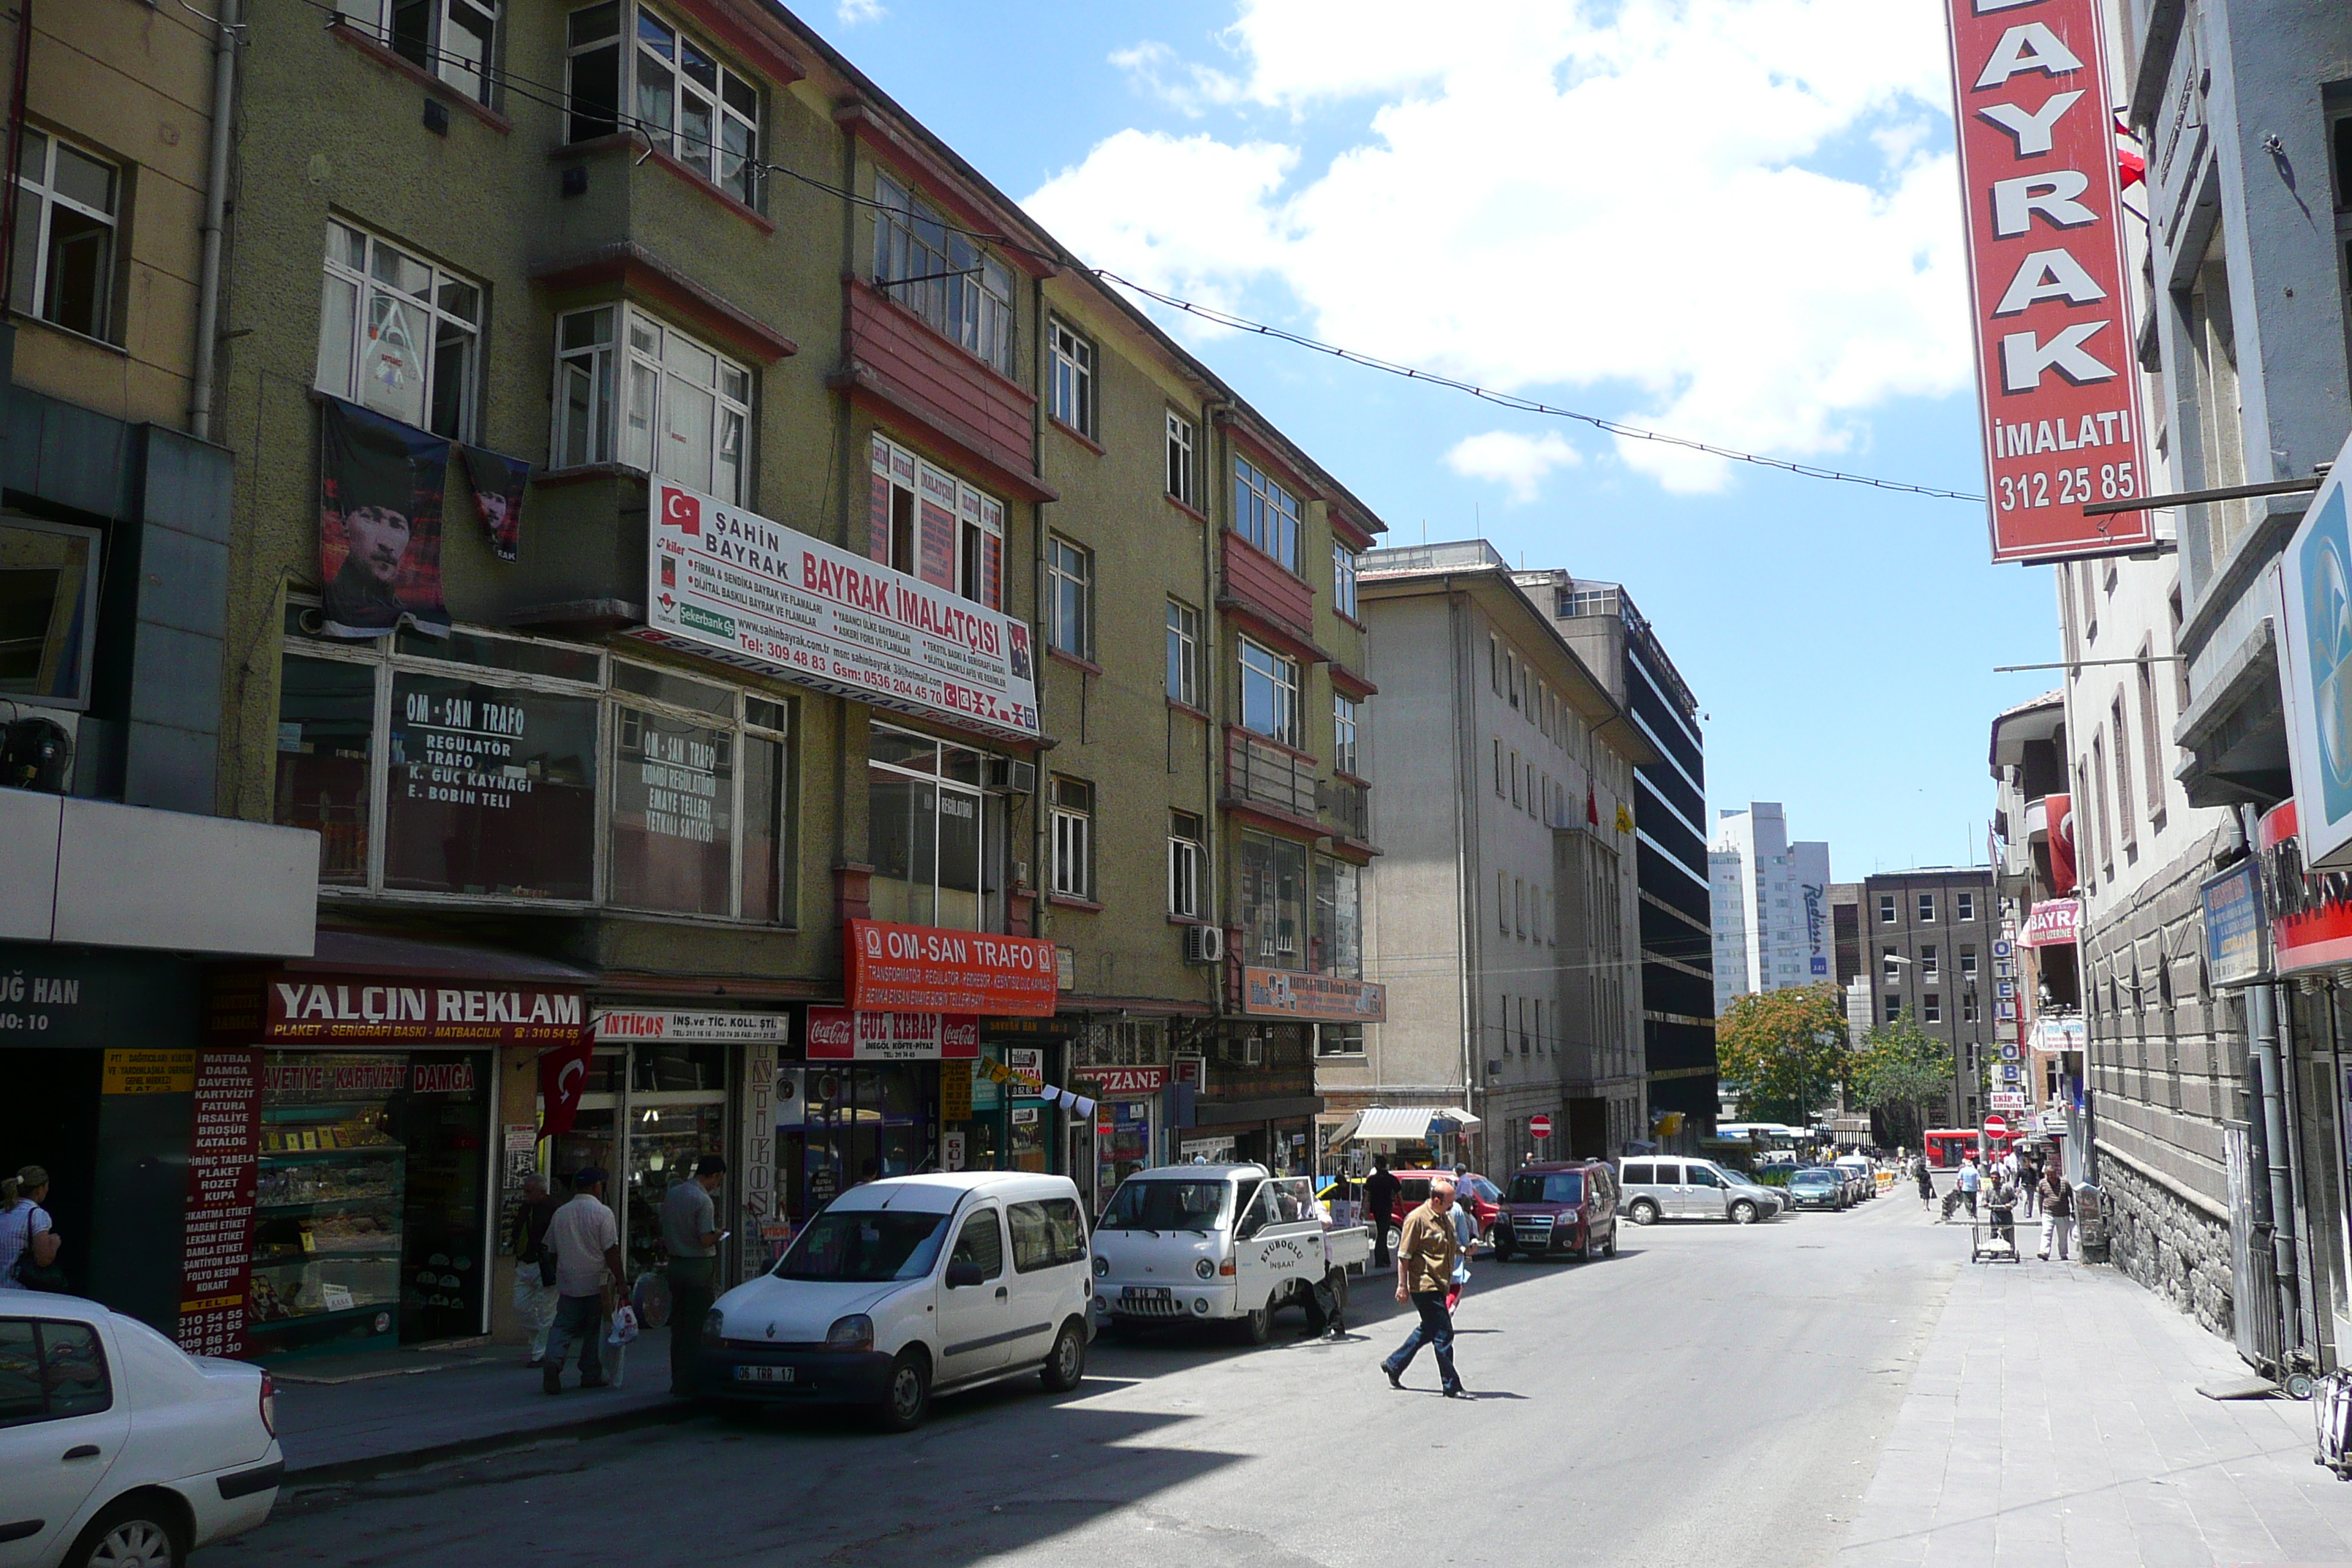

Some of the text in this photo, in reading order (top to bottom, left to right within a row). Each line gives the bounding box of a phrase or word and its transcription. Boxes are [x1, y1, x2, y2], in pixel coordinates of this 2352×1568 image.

[1970, 0, 2119, 391] AYRAK
[1994, 410, 2129, 459] İMALATI
[1999, 461, 2135, 511] 312 25 85
[715, 512, 779, 552] ŞAHİN
[666, 540, 685, 557] kiler
[706, 532, 788, 580] BAYRAK
[694, 559, 823, 614] FİRMA SENDİKA BAYRAK VE FLAMALARI
[694, 576, 817, 627] DİJİTAL BASKILI BAYRAK VE FLAMALAR
[802, 551, 1000, 655] BAYRAK İMALATÇISI
[680, 606, 723, 630] Şekerbank
[738, 618, 850, 660] www.sahinbayrak.com.tr msn:
[740, 633, 942, 704] Tel: 309 48 83 Gsm: 0536 204 45 70
[791, 676, 919, 712] BAYRAK
[407, 693, 524, 735] OM SAN TRAFO
[426, 734, 510, 757] REGÜLATÖR
[644, 731, 715, 770] OM SAN TRAFO
[426, 750, 473, 768] TRAFO
[410, 766, 461, 785] K. GÜÇ
[642, 764, 716, 797] KOMBİ REGÜLATÖRÜ
[429, 786, 475, 804] BOBİN
[482, 793, 510, 808] TELİ
[649, 788, 711, 821] EMAYE TELLERİ
[646, 810, 714, 843] YETKİLİ SATICISI
[1801, 883, 1827, 955] Radisson
[888, 932, 967, 963] OM-SAN
[973, 941, 1033, 970] TRAFO
[1994, 941, 2013, 1017] OTEL
[33, 977, 80, 1004] HAN
[276, 982, 581, 1025] YALÇIN REKLAM
[29, 1014, 49, 1030] 10
[274, 1021, 579, 1039] PLAKET SERİGRAFİ BASKI MATBAACILIK 310 54 55
[708, 1016, 727, 1027] TİC.
[730, 1018, 757, 1028] KOLL.
[760, 1017, 777, 1030] ŞTİ.
[892, 1012, 938, 1040] KEBAP
[865, 1040, 889, 1049] İNEGÖL
[203, 1054, 252, 1063] MATBAA
[206, 1066, 248, 1075] DAMGA
[334, 1060, 475, 1093] KARTVİZİT DAMGA
[197, 1076, 253, 1087] DAVETİYE
[195, 1088, 255, 1099] KARTVİZİT
[201, 1101, 246, 1111] FATURA
[197, 1112, 249, 1123] İRSALİYE
[198, 1124, 246, 1137] BROŞÜR
[196, 1137, 247, 1147] KATALOG
[220, 1154, 255, 1165] TABELA
[197, 1166, 241, 1177] PLAKET
[201, 1178, 238, 1190] ROZET
[204, 1191, 235, 1202] KUPA
[225, 1206, 252, 1218] ETİKET
[186, 1218, 246, 1233] MADENİ ETİKET
[186, 1230, 245, 1245] LEKSAN ETİKET
[186, 1243, 244, 1257] DAMLA ETİKET
[1260, 1239, 1304, 1264] EYÜBOĞLU
[184, 1254, 249, 1272] ŞANTİYON BASKI
[1270, 1261, 1294, 1270] İNŞAAT
[187, 1266, 239, 1281] FOLYO KESİM
[196, 1280, 229, 1292] KOKART
[196, 1299, 229, 1308] TEL:
[178, 1308, 244, 1327] 310 54 55
[178, 1319, 242, 1338] 310 73 65
[206, 1334, 223, 1345] 86
[205, 1345, 222, 1357] 20
[225, 1342, 242, 1353] 30
